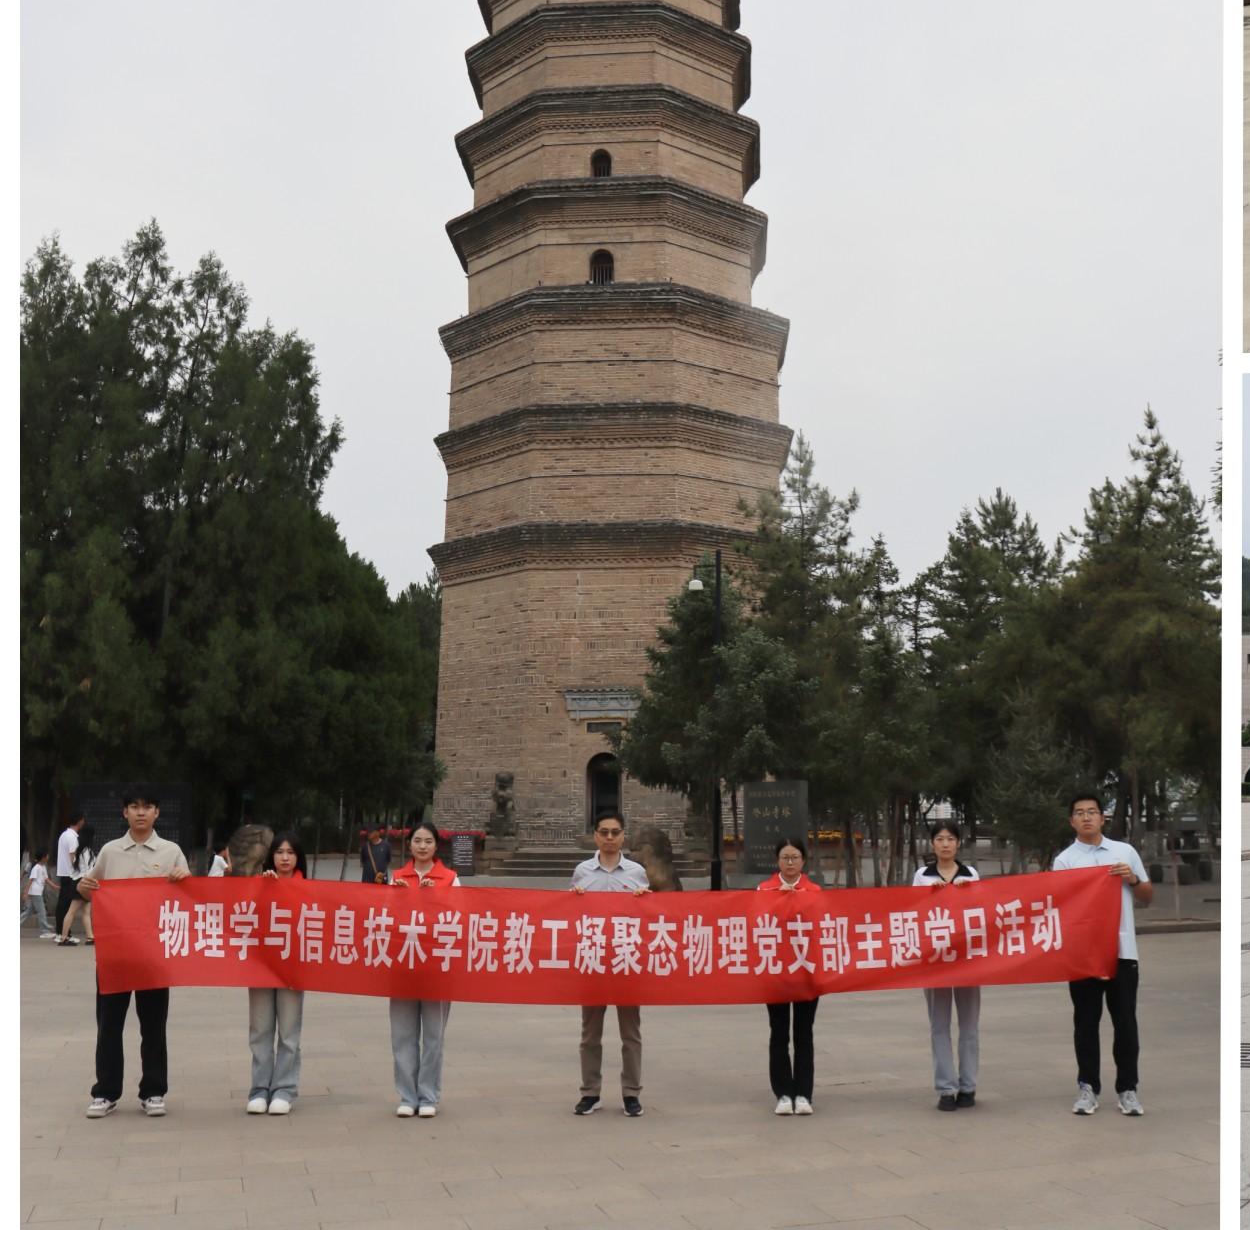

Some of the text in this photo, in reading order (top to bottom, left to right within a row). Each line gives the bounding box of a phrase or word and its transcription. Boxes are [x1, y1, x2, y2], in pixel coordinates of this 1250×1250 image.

[158, 894, 1064, 978] 物理学与信息技术学院教工凝聚态物理党支部主题党日活动
